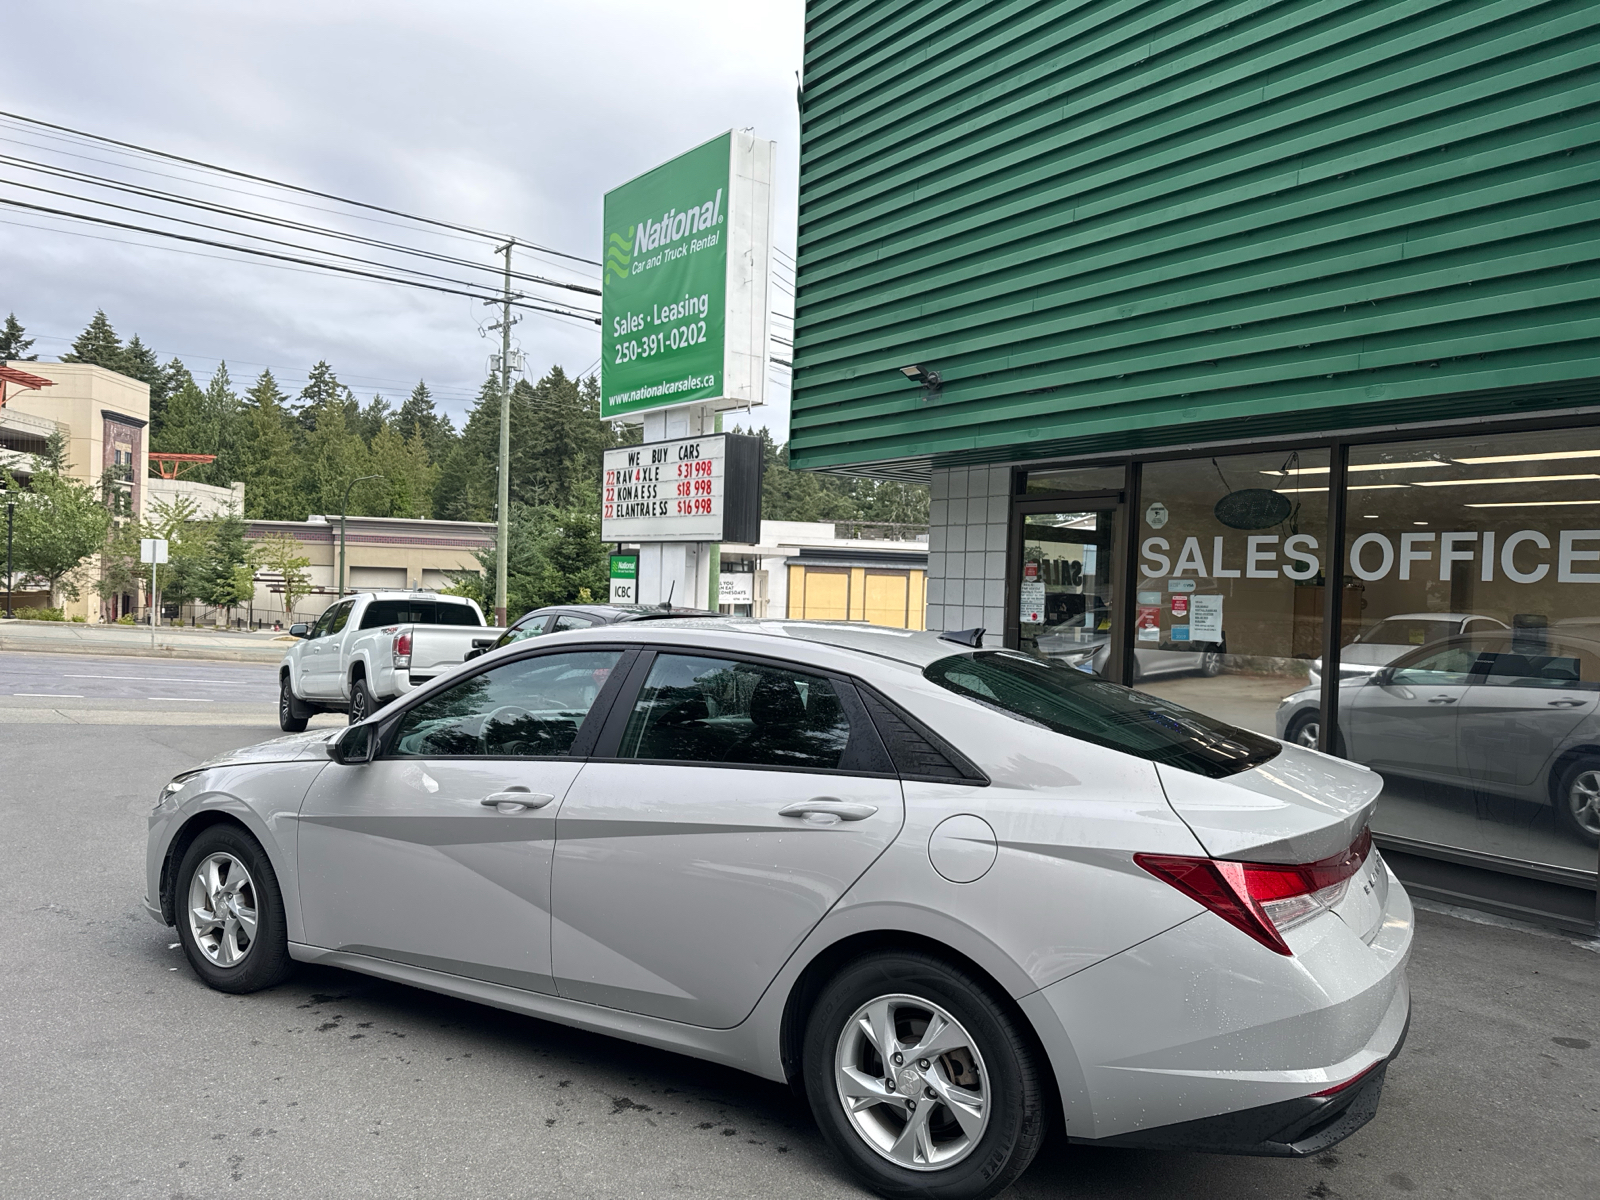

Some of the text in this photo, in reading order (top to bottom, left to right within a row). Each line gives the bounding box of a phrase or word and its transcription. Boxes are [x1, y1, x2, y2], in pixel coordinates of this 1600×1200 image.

[631, 231, 720, 275] Car and Truck Rental
[613, 294, 709, 337] Sales Leasing
[615, 321, 707, 365] 250-391-0202
[608, 374, 715, 406] www.nationalcarsales.ca
[628, 443, 700, 467] WE BUY CARS
[606, 471, 615, 486] 22
[605, 488, 615, 502] 22
[604, 504, 614, 519] 22
[1222, 497, 1281, 518] OPEN
[1140, 529, 1600, 584] SALES OFFICE
[614, 585, 631, 598] ICBC
